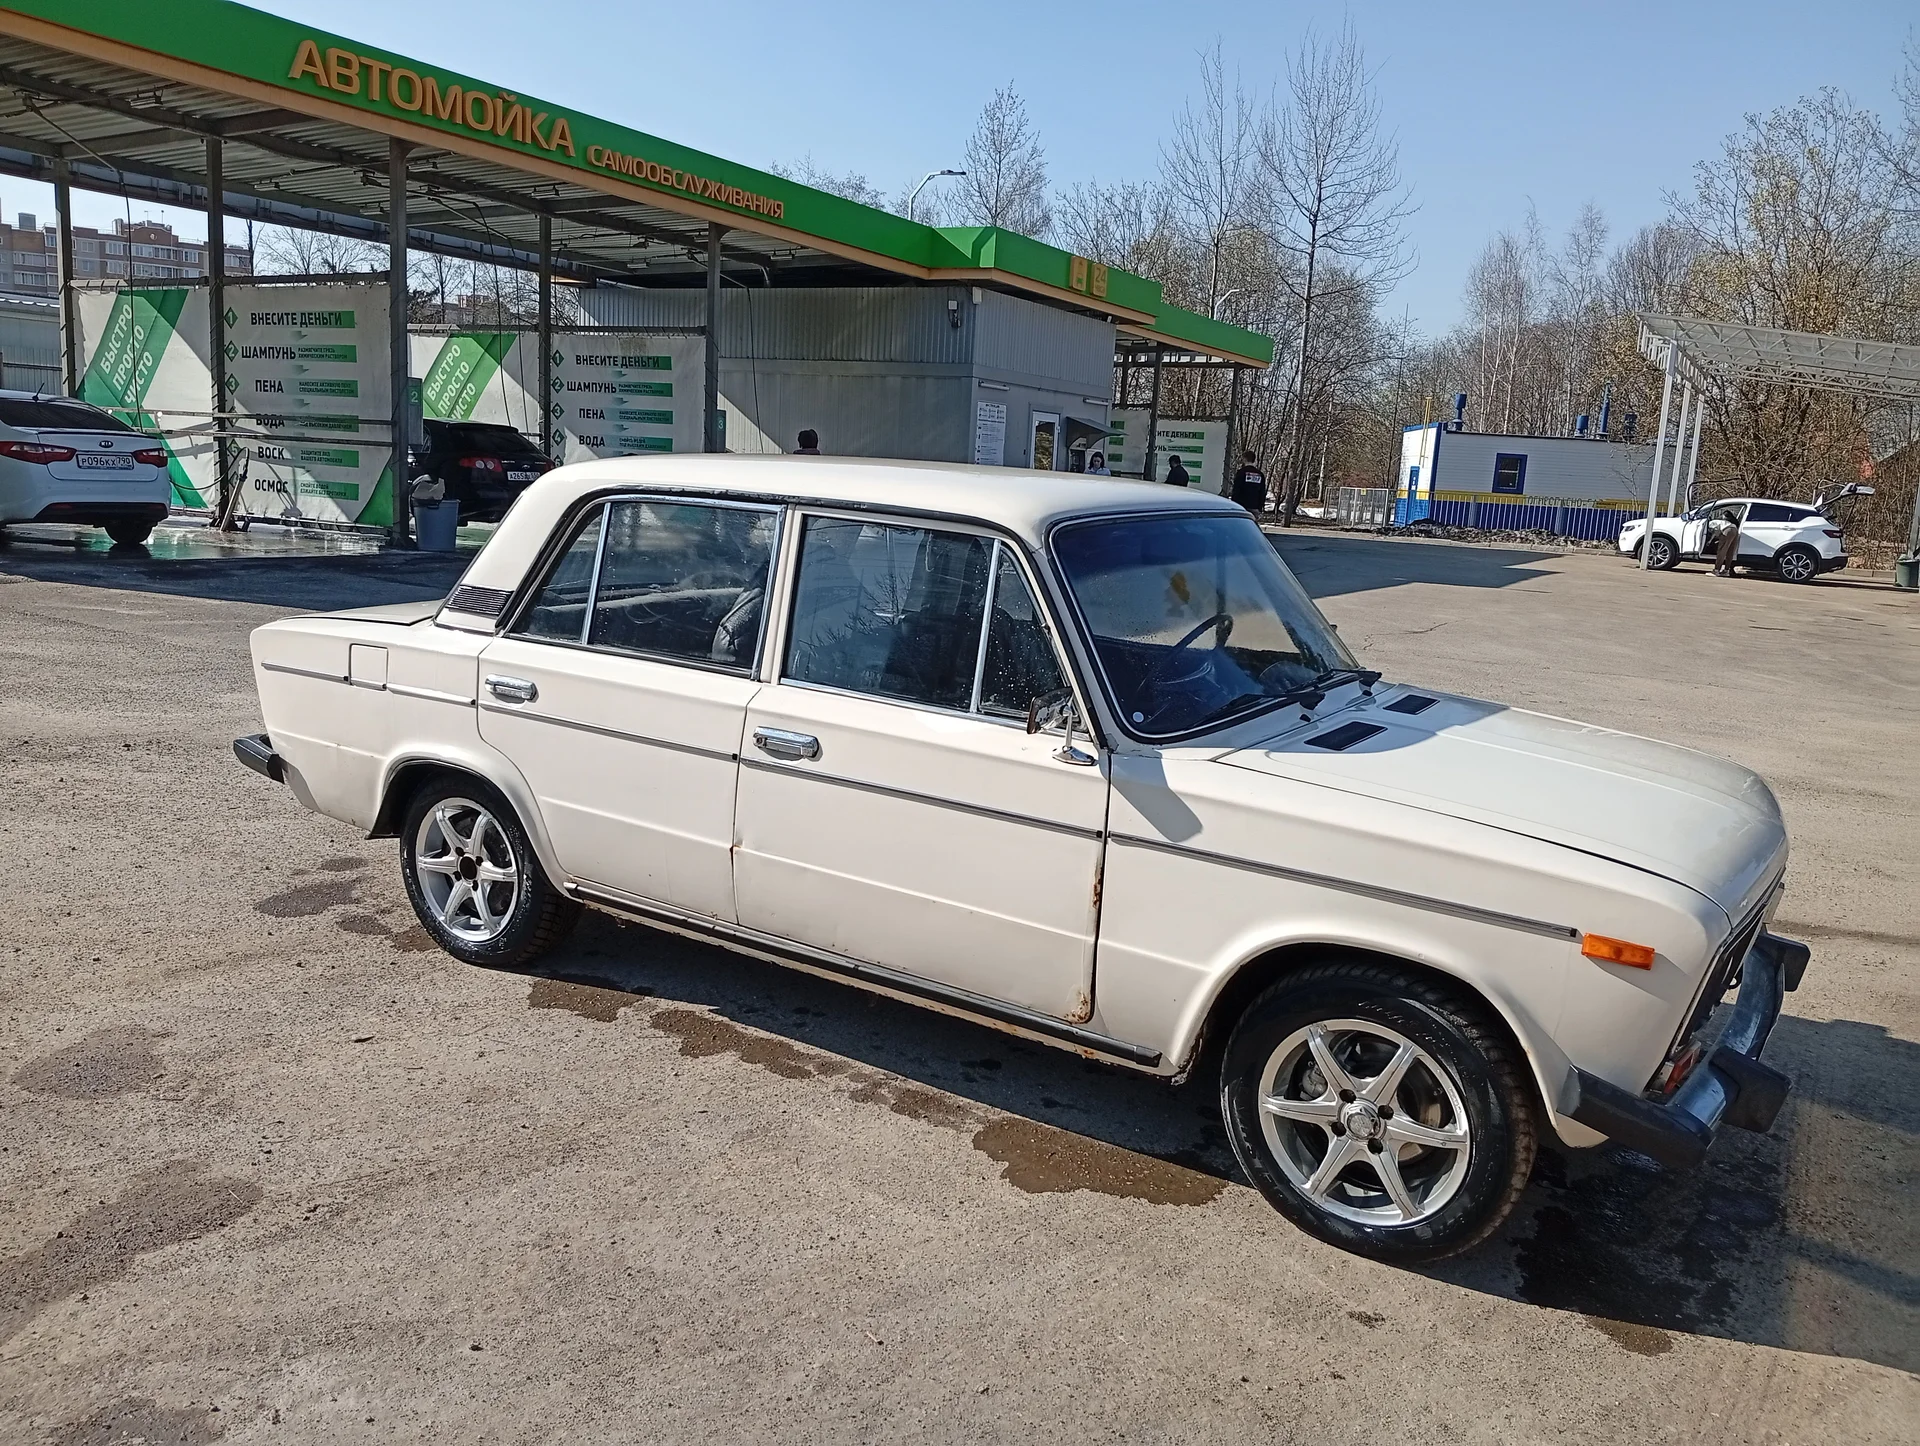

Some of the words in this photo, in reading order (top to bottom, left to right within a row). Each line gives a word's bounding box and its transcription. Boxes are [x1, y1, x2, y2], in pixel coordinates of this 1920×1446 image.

[289, 39, 576, 157] АВТОМОЙКА
[587, 145, 785, 219] САМООБСЛУЖИВАНИЯ
[1095, 267, 1106, 284] 24
[227, 312, 233, 324] 1
[251, 312, 297, 326] ВНЕСИТЕ
[300, 313, 342, 328] ДЕНЬГИ
[100, 304, 132, 374] БЫСТРО
[113, 325, 144, 391] ПРОСТО
[228, 346, 235, 357] 2
[242, 346, 296, 359] ШАМПУНЬ
[555, 355, 560, 364] 1
[576, 355, 618, 367] ВНЕСИТЕ
[620, 356, 660, 368] ДЕНЬГИ
[125, 352, 153, 403] ЧИСТО
[427, 345, 460, 401] БЫСТРО
[229, 379, 236, 390] 3
[255, 380, 284, 393] ПЕНА
[438, 362, 470, 415] ПРОСТО
[555, 381, 561, 390] 2
[567, 381, 617, 393] ШАМПУНЬ
[410, 392, 418, 403] 2
[555, 407, 561, 416] 3
[579, 409, 605, 420] ПЕНА
[718, 420, 723, 429] 3
[554, 433, 561, 442] 4
[579, 435, 605, 448] ВОДА
[258, 446, 285, 460] ВОСК
[255, 479, 288, 493] ОСМОС
